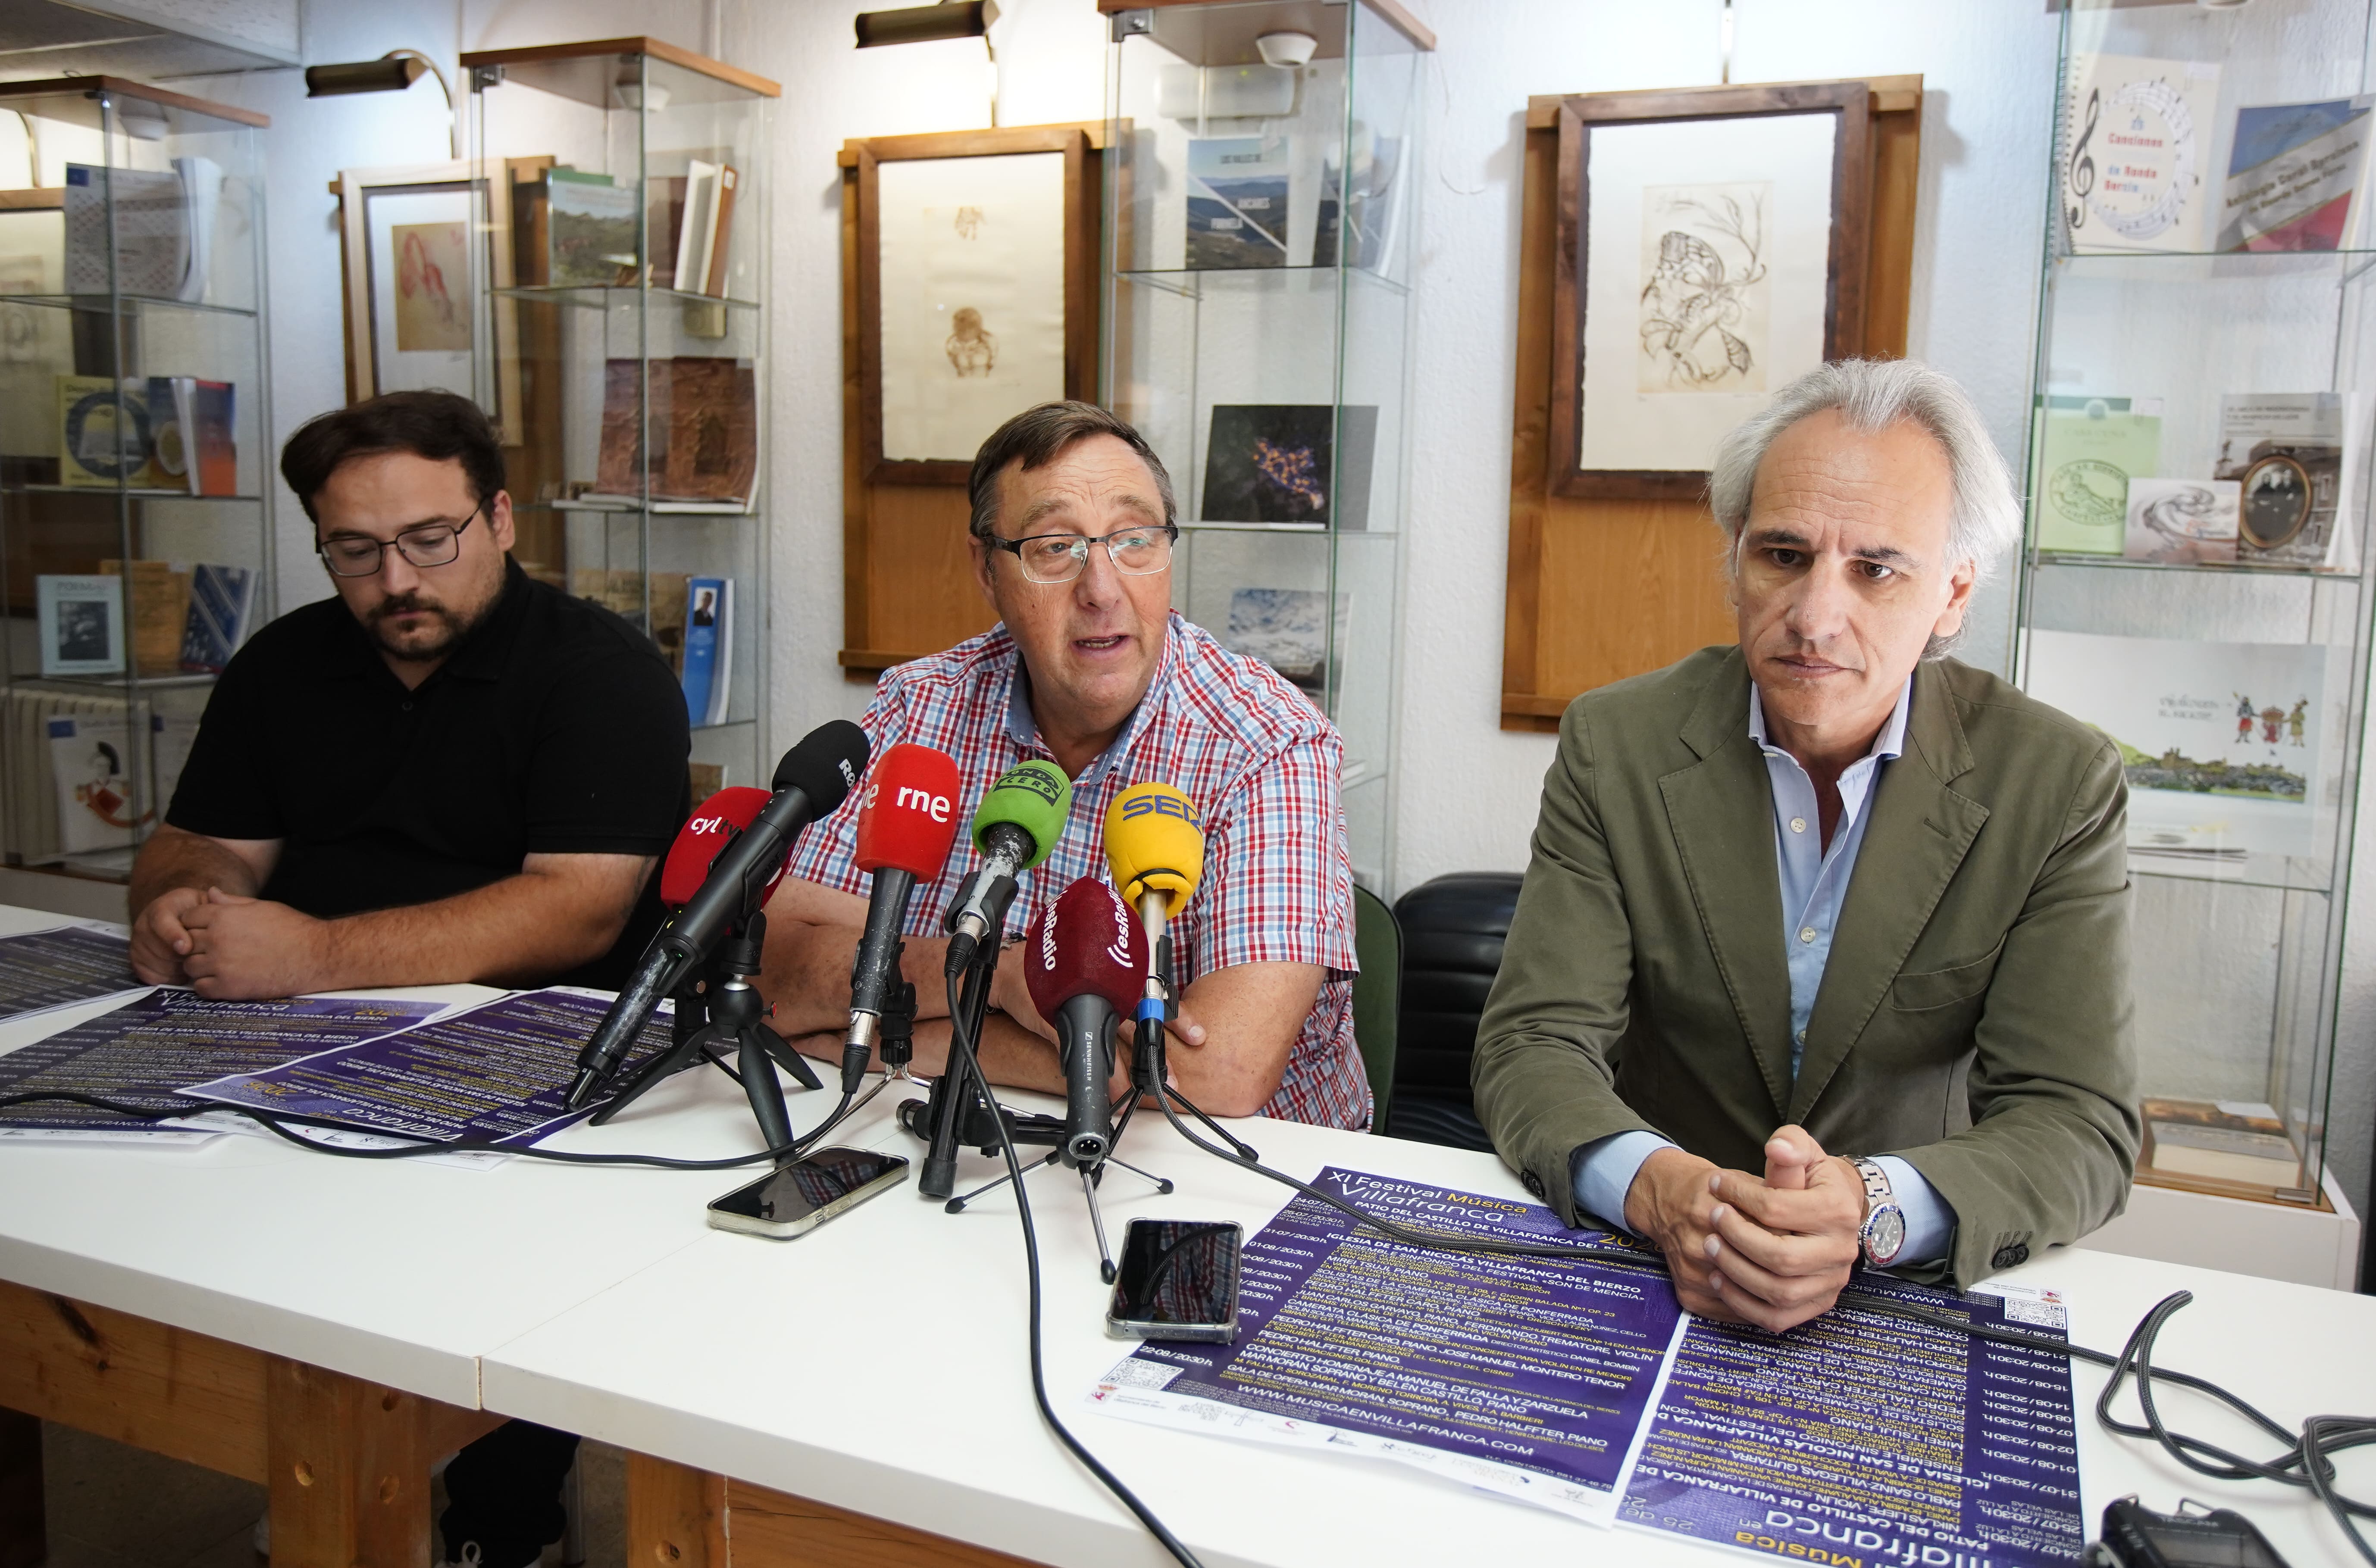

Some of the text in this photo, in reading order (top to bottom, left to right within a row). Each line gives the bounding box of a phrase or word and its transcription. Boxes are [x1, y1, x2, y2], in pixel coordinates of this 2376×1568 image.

[1007, 778, 1051, 793] CERO
[1008, 768, 1055, 786] ONDA
[897, 786, 950, 823] rne
[1043, 902, 1058, 971] esRadio
[1108, 888, 1129, 949] esRadio
[160, 997, 291, 1011] Villafranca
[342, 1108, 463, 1142] Villafranca
[1327, 1171, 1527, 1213] XI Festival Música
[1342, 1183, 1503, 1222] Villafranca
[1354, 1201, 1389, 1211] PATIO
[1390, 1207, 1412, 1216] DEL
[1415, 1212, 1471, 1227] CASTILLO
[1492, 1226, 1573, 1245] VILLAFRANCA
[1368, 1210, 1401, 1220] NIKLAS
[1326, 1232, 1371, 1245] IGLESIA
[1392, 1244, 1418, 1253] SAN
[1420, 1249, 1474, 1263] NICOLÁS
[1478, 1259, 1562, 1279] VILLAFRANCA
[1565, 1275, 1590, 1284] DEL
[1593, 1280, 1640, 1293] BIERZO
[1326, 1255, 1357, 1265] MIREI
[1393, 1267, 1428, 1278] PIANO
[1339, 1242, 1398, 1256] ENSEMBLE
[1399, 1253, 1460, 1267] SINFÓNICO
[1461, 1264, 1483, 1272] DEL
[1486, 1268, 1537, 1282] FESTIVAL
[1315, 1268, 1365, 1281] SOLISTAS
[1397, 1283, 1453, 1298] CAMERATA
[1456, 1294, 1501, 1306] CLÁSICA
[1520, 1306, 1593, 1324] PONFERRADA
[1296, 1290, 1325, 1299] JUAN
[1326, 1294, 1369, 1307] CARLOS
[1464, 1321, 1538, 1339] FERDINANDO
[1615, 1349, 1653, 1361] VIOLÍN
[1272, 1314, 1311, 1326] PEDRO
[1310, 1322, 1367, 1338] HALFFTER
[1439, 1348, 1470, 1359] JOSÉ
[1470, 1353, 1519, 1368] MANUEL
[1521, 1363, 1582, 1380] MONTERO
[1584, 1375, 1625, 1389] TENOR
[1240, 1350, 1267, 1361] MAR
[1311, 1364, 1367, 1381] SOPRANO
[1377, 1378, 1419, 1392] BELÉN
[1486, 1399, 1527, 1413] PIANO
[1246, 1343, 1316, 1362] CONCIERTO
[1316, 1358, 1386, 1377] HOMENAJE
[1396, 1374, 1448, 1390] MANUEL
[1450, 1384, 1470, 1394] DE
[1470, 1388, 1509, 1402] FALLA
[1520, 1399, 1587, 1418] ZARZUELA
[1227, 1364, 1255, 1375] GALA
[1311, 1381, 1339, 1392] MAR
[1454, 1411, 1498, 1424] PEDRO
[1567, 1433, 1608, 1446] PIANO
[1238, 1385, 1533, 1455] WWW.MUSICAENVILLAFRANCA.COM
[1673, 1415, 1989, 1489] IGLESIA DE SAN NICOLÁS VILLAFRANCA
[1625, 1508, 1694, 1530] 25 de
[1662, 1469, 1988, 1550] PATIO DEL CASTILLO DE VILLAFRANCA
[1913, 1491, 1960, 1508] PABLO
[1739, 1518, 1762, 1529] en
[1909, 1514, 1960, 1532] NIKLAS
[1736, 1531, 1862, 1568] Música
